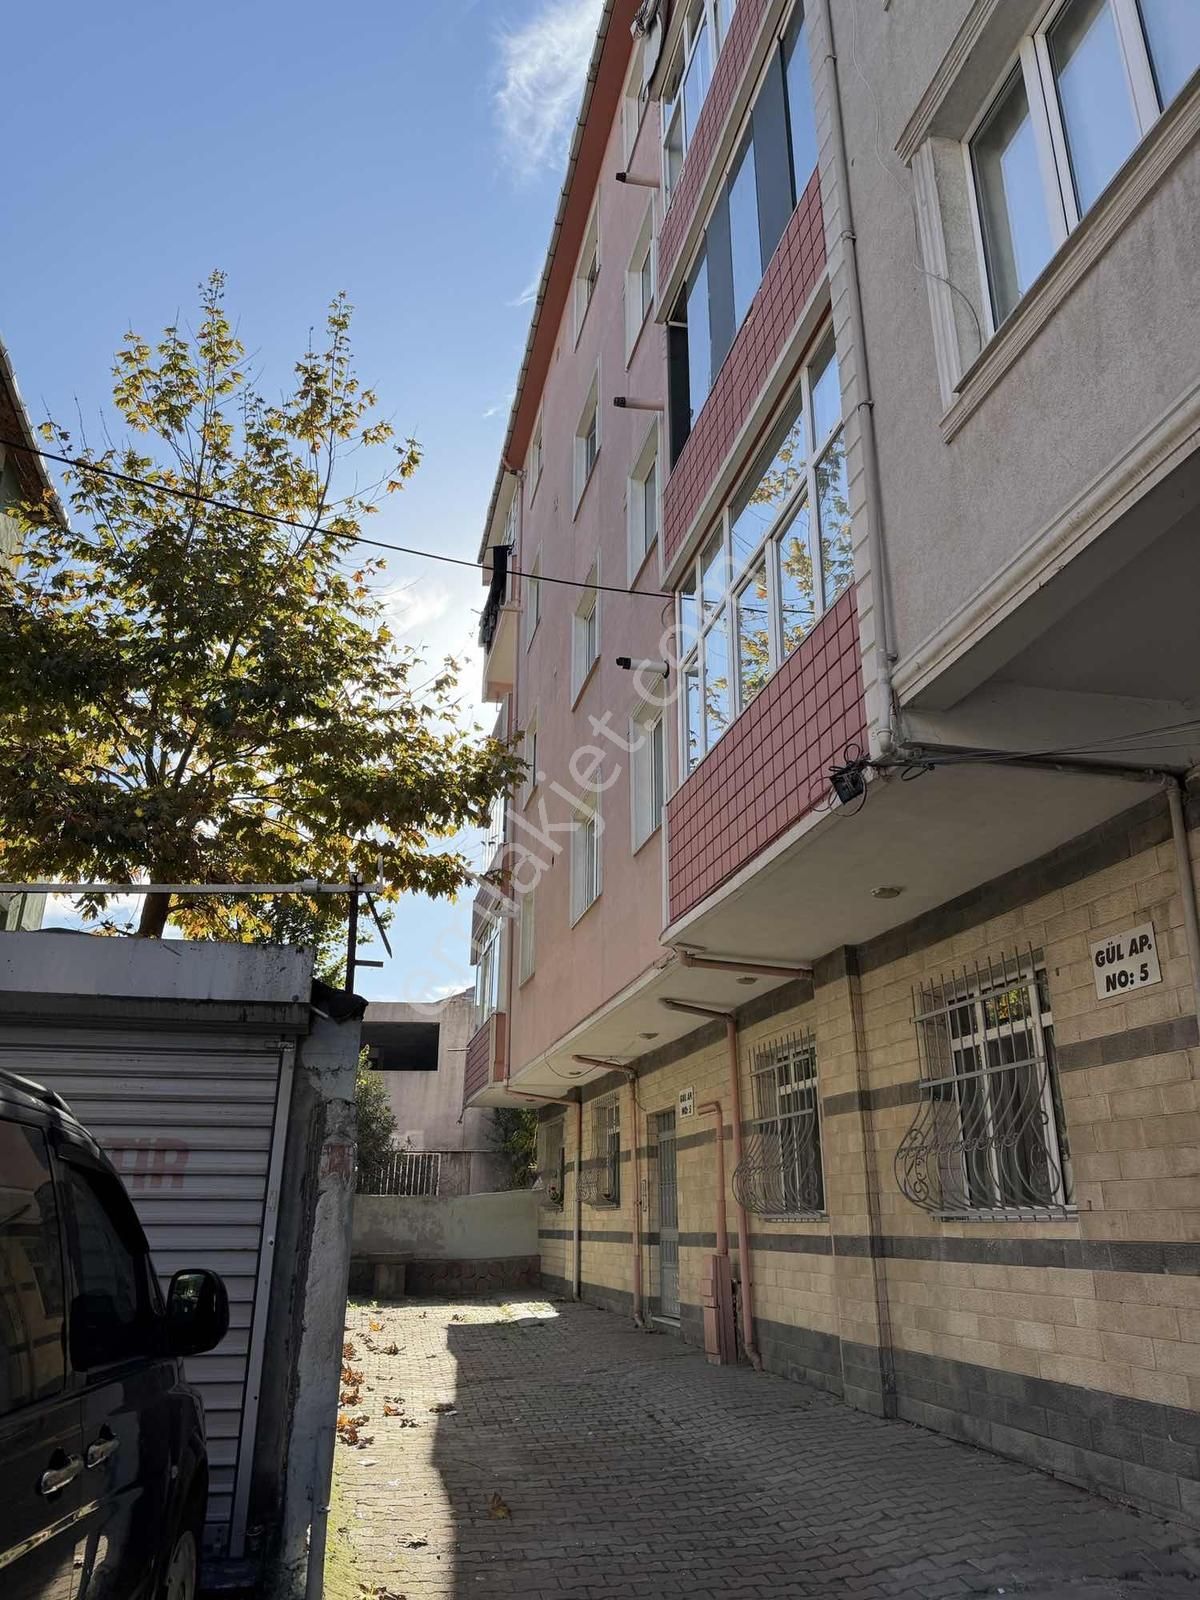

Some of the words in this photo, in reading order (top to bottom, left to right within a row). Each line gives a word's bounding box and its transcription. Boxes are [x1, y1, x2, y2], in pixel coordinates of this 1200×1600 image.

[1095, 941, 1124, 967] GÜL
[1128, 934, 1152, 957] AP.
[1105, 970, 1134, 992] NO:
[1139, 963, 1149, 981] 5
